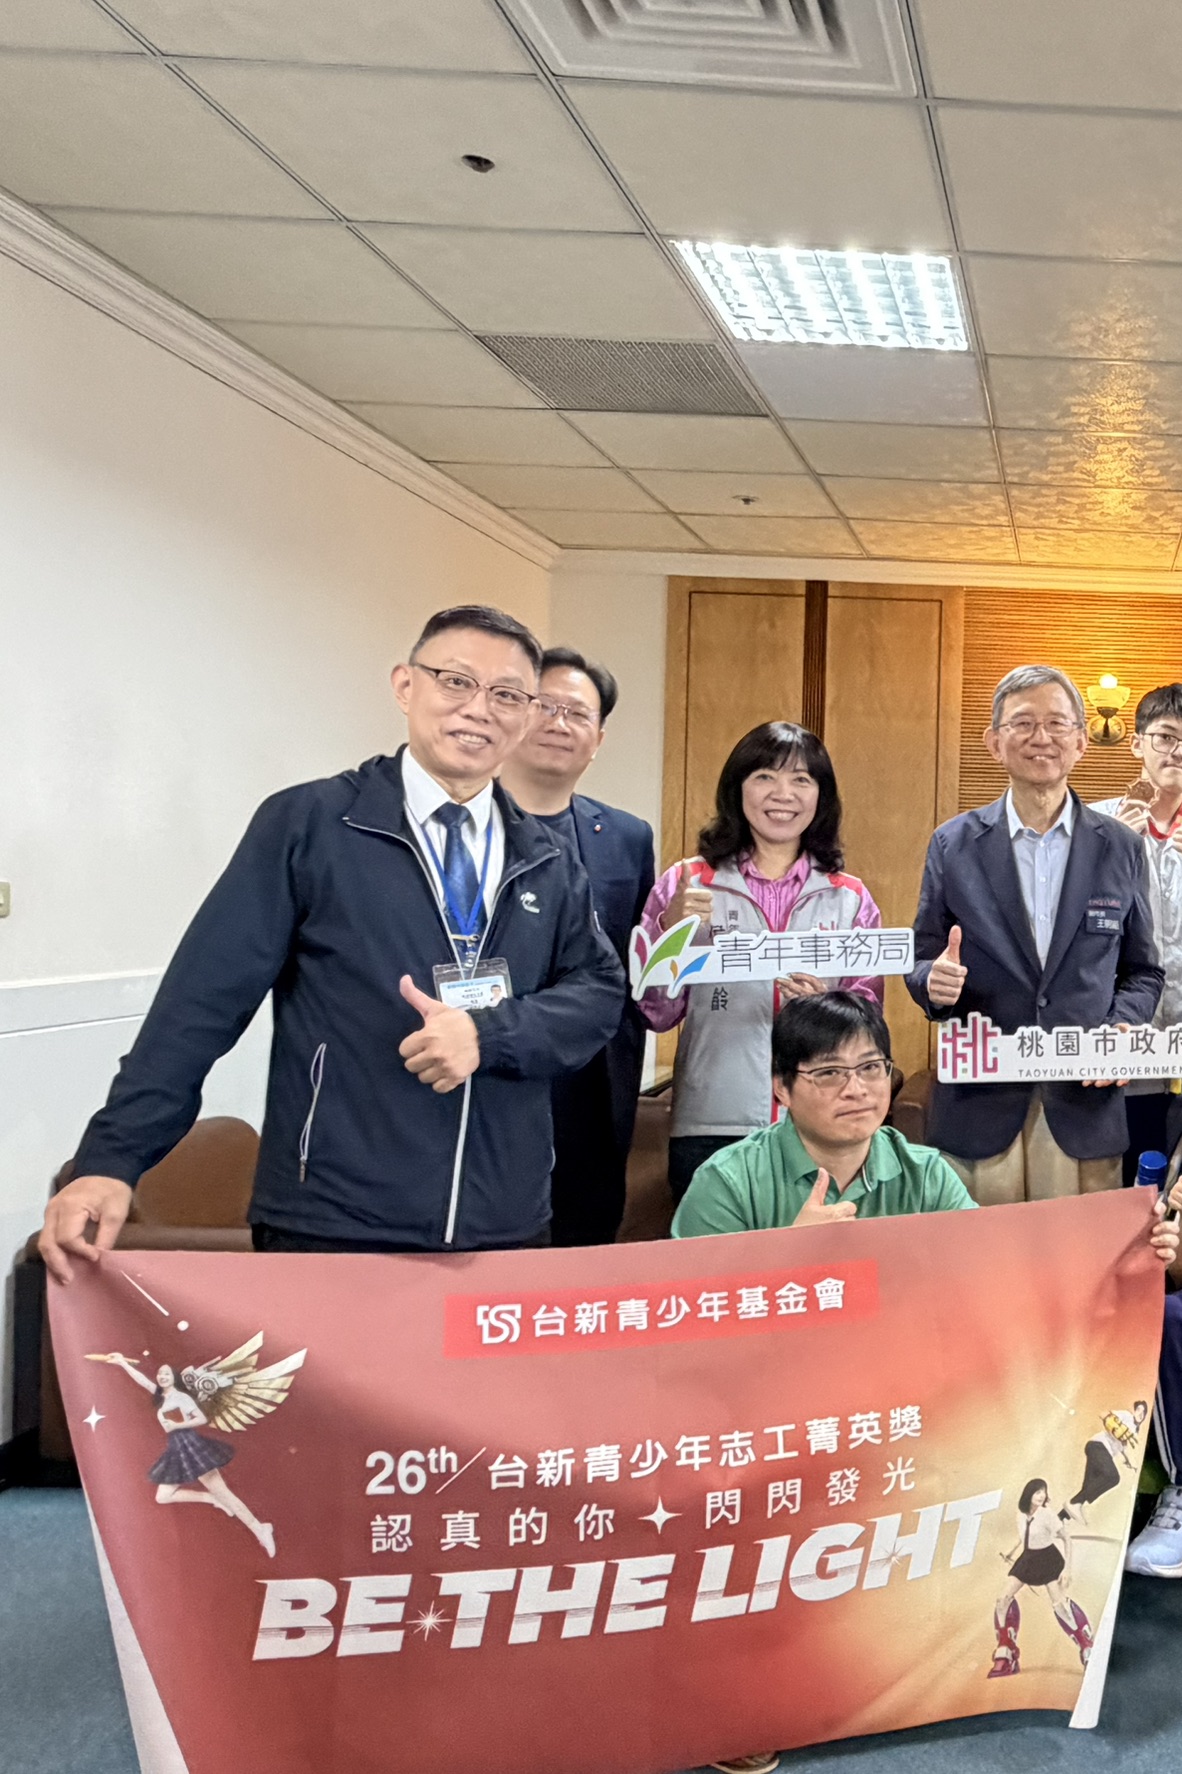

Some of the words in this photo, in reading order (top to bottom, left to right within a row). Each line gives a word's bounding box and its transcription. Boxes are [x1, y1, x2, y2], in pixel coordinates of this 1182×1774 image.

[717, 932, 910, 974] 青年事務局
[1018, 1067, 1074, 1078] TAOYUAN
[1079, 1067, 1106, 1077] CITY
[532, 1277, 846, 1338] 台新青少年基金會
[365, 1446, 458, 1496] 26th
[487, 1405, 922, 1491] 台新青少年志工菁英獎
[371, 1503, 615, 1554] 認真的你
[705, 1457, 916, 1529] 閃閃發光
[252, 1573, 413, 1662] BE
[431, 1553, 676, 1650] THE
[691, 1488, 1003, 1624] LIGHT
